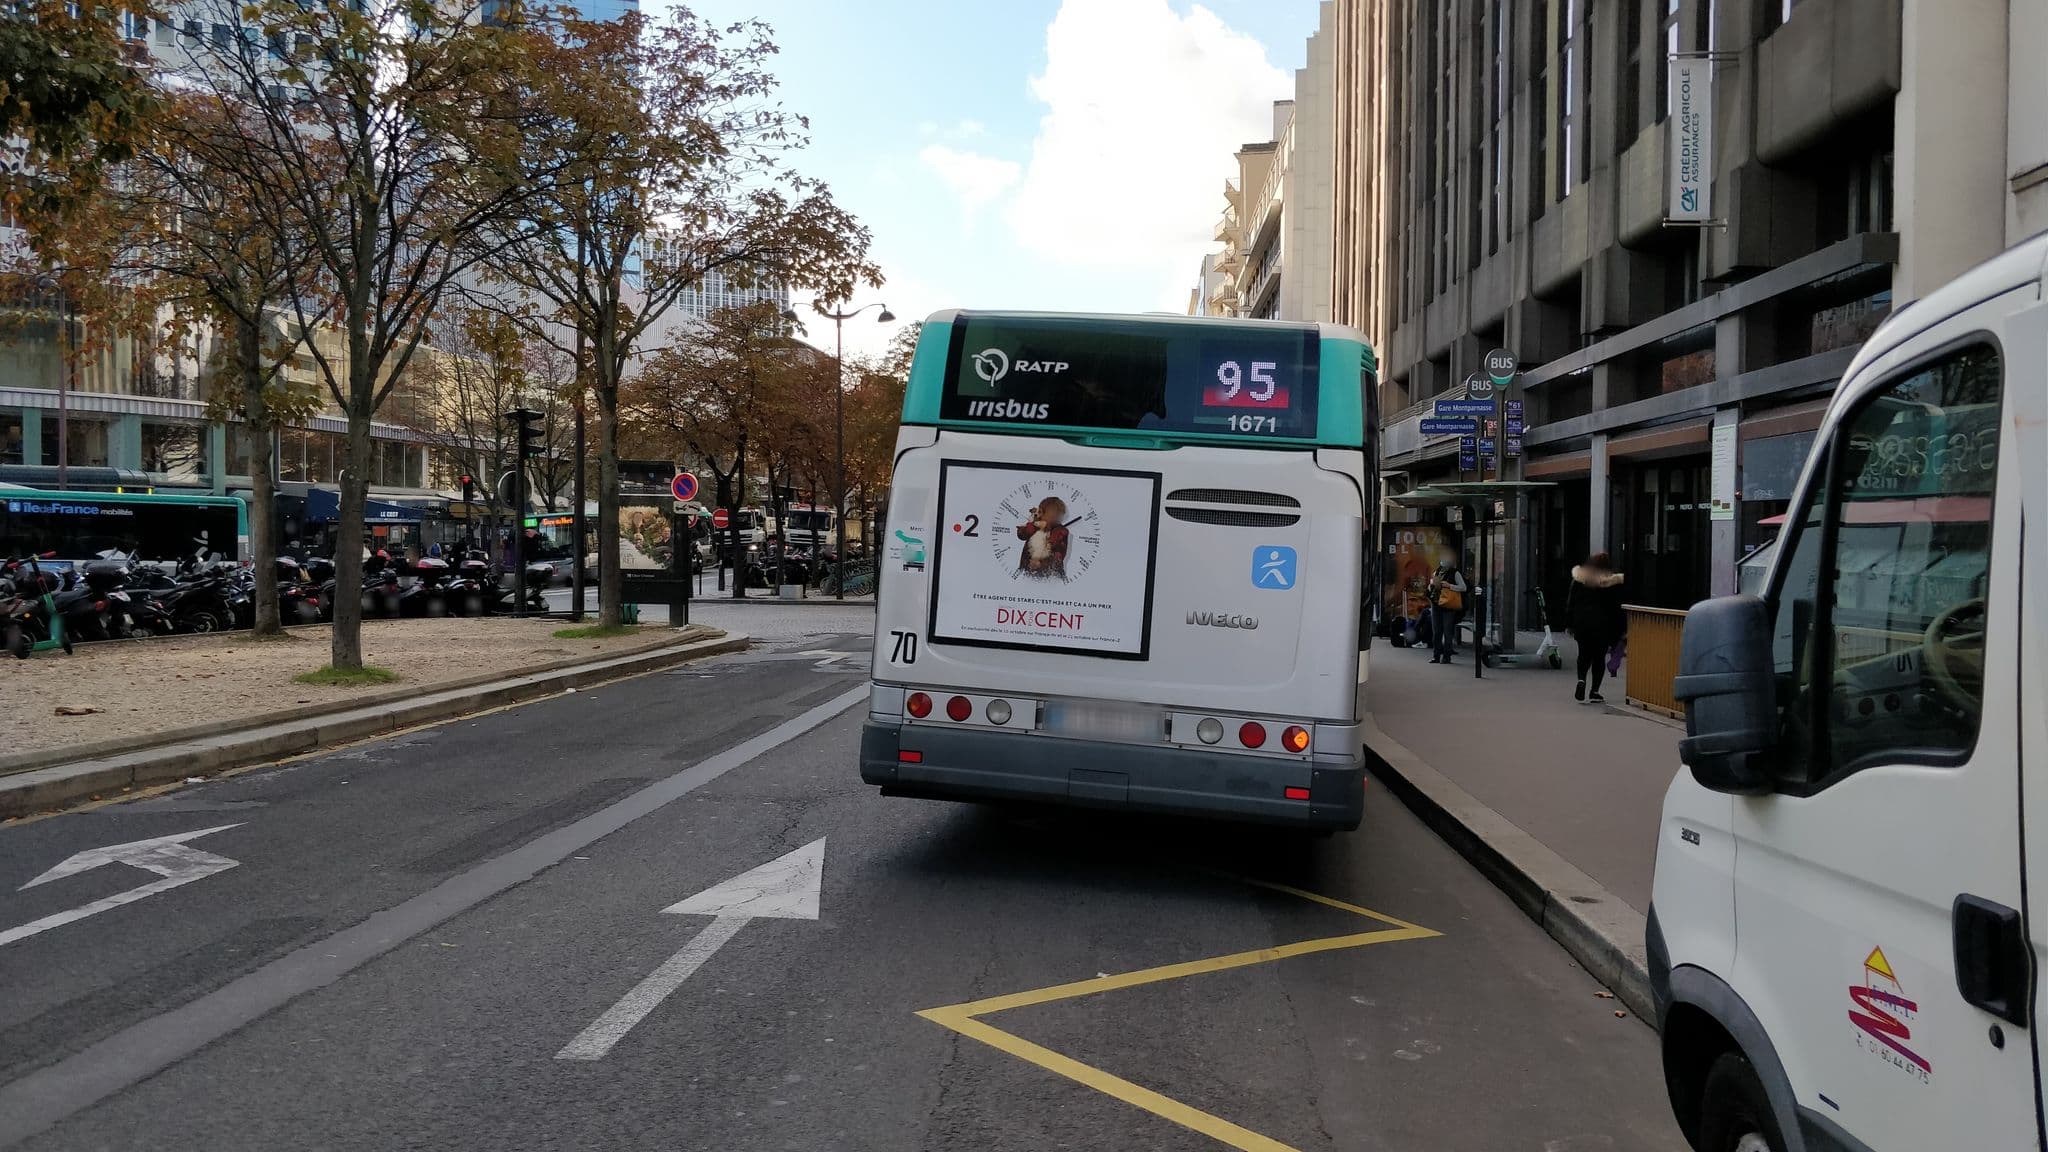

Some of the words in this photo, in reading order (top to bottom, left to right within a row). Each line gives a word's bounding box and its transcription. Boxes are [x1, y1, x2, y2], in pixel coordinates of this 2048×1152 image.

[1681, 67, 1691, 134] AGRICOLE
[1692, 112, 1700, 182] ASSURANCES
[1680, 134, 1691, 183] CRÉDIT
[1014, 358, 1070, 374] RATP
[1490, 357, 1513, 369] BUS
[1216, 360, 1277, 402] 95
[1471, 380, 1492, 391] BUS
[968, 398, 1050, 420] irisbus
[1227, 415, 1277, 434] 1671
[963, 514, 979, 537] 2
[988, 594, 1008, 602] AGENT
[997, 608, 1028, 626] DIX
[1034, 611, 1084, 631] CENT
[1186, 608, 1259, 630] IVECO
[890, 630, 918, 664] 70
